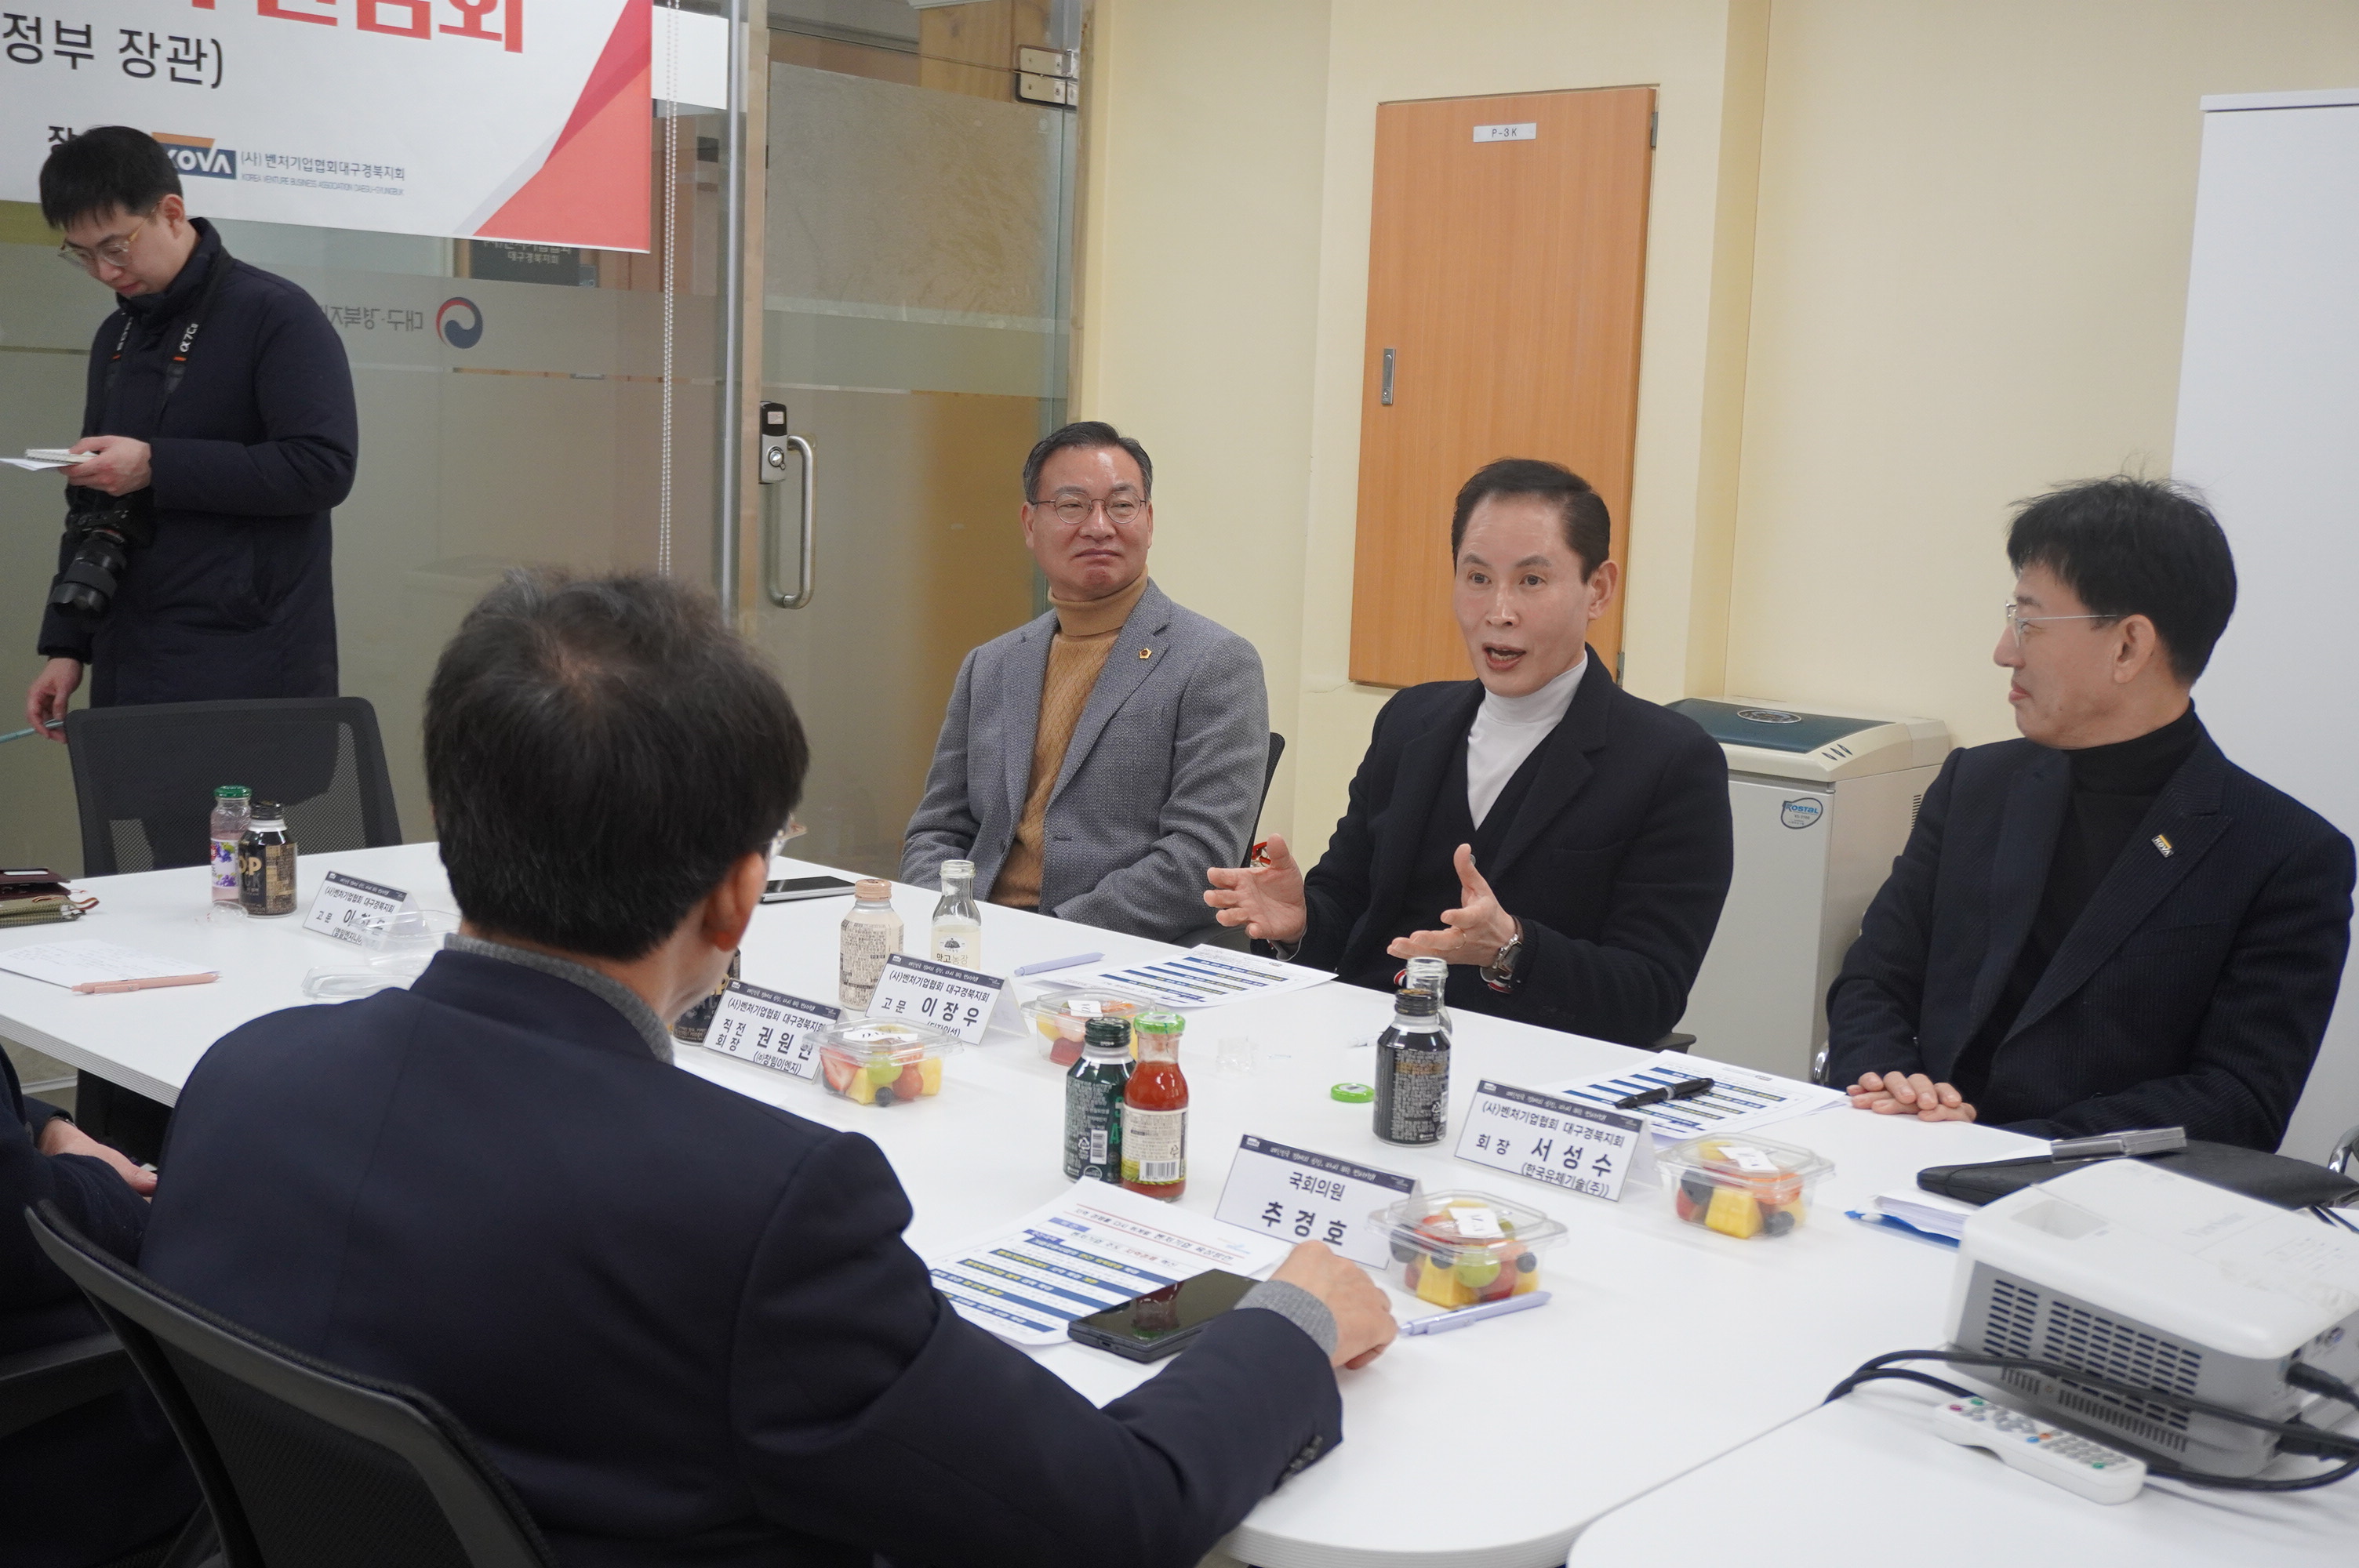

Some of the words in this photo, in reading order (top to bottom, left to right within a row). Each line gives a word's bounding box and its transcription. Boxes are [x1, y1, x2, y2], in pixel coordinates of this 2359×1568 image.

[118, 27, 224, 89] 장관)
[889, 970, 944, 992] (사)벤처기업협회
[945, 983, 990, 1003] 대구경북지회
[727, 997, 782, 1022] (사)벤처기업협회
[1482, 1100, 1560, 1131] (사)벤처기업협회
[1562, 1121, 1626, 1149] 대구경북지회
[1289, 1171, 1347, 1202] 국회의원
